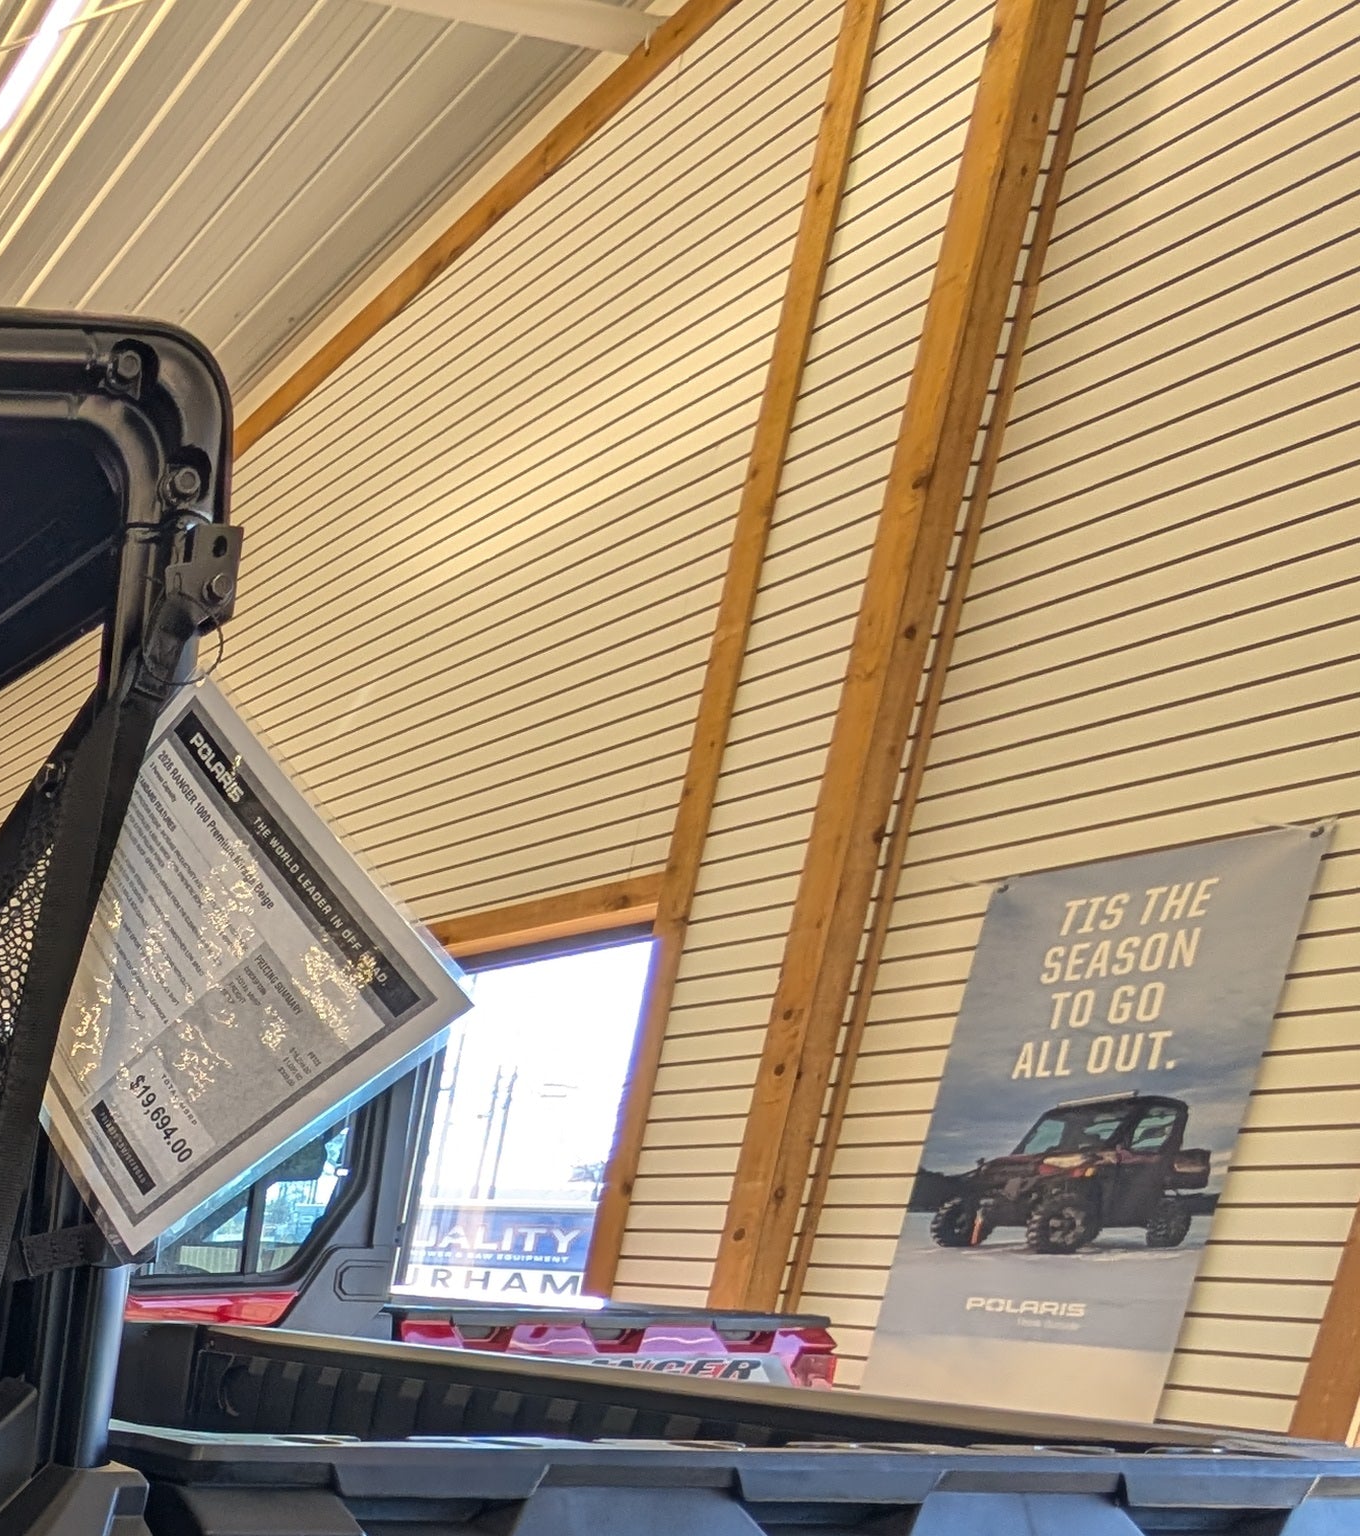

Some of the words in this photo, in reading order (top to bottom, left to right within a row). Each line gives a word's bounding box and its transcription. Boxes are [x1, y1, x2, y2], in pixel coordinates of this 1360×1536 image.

[187, 732, 245, 804] POLARIS
[167, 767, 198, 805] RANGER
[193, 801, 211, 823] 1000
[205, 820, 236, 859] Premium
[252, 882, 275, 911] Beige
[252, 816, 271, 838] THE
[267, 836, 300, 874] WORLD
[296, 873, 332, 915] LEADER
[329, 914, 343, 929] IN
[340, 928, 361, 952] OFF
[359, 950, 390, 987] RAD.
[1060, 892, 1131, 936] TIS
[1140, 877, 1220, 926] THE
[1040, 927, 1202, 984] SEASON
[253, 954, 278, 984] PRICING
[273, 981, 303, 1016] SUMMARY
[1050, 989, 1095, 1030] TO
[1107, 981, 1166, 1024] GO
[1011, 1038, 1071, 1080] ALL
[1086, 1030, 1178, 1075] OUT.
[127, 1072, 194, 1164] $19,694.00
[412, 1224, 581, 1254] UALITY
[405, 1266, 582, 1297] URHAM
[965, 1296, 1088, 1317] POLARIS
